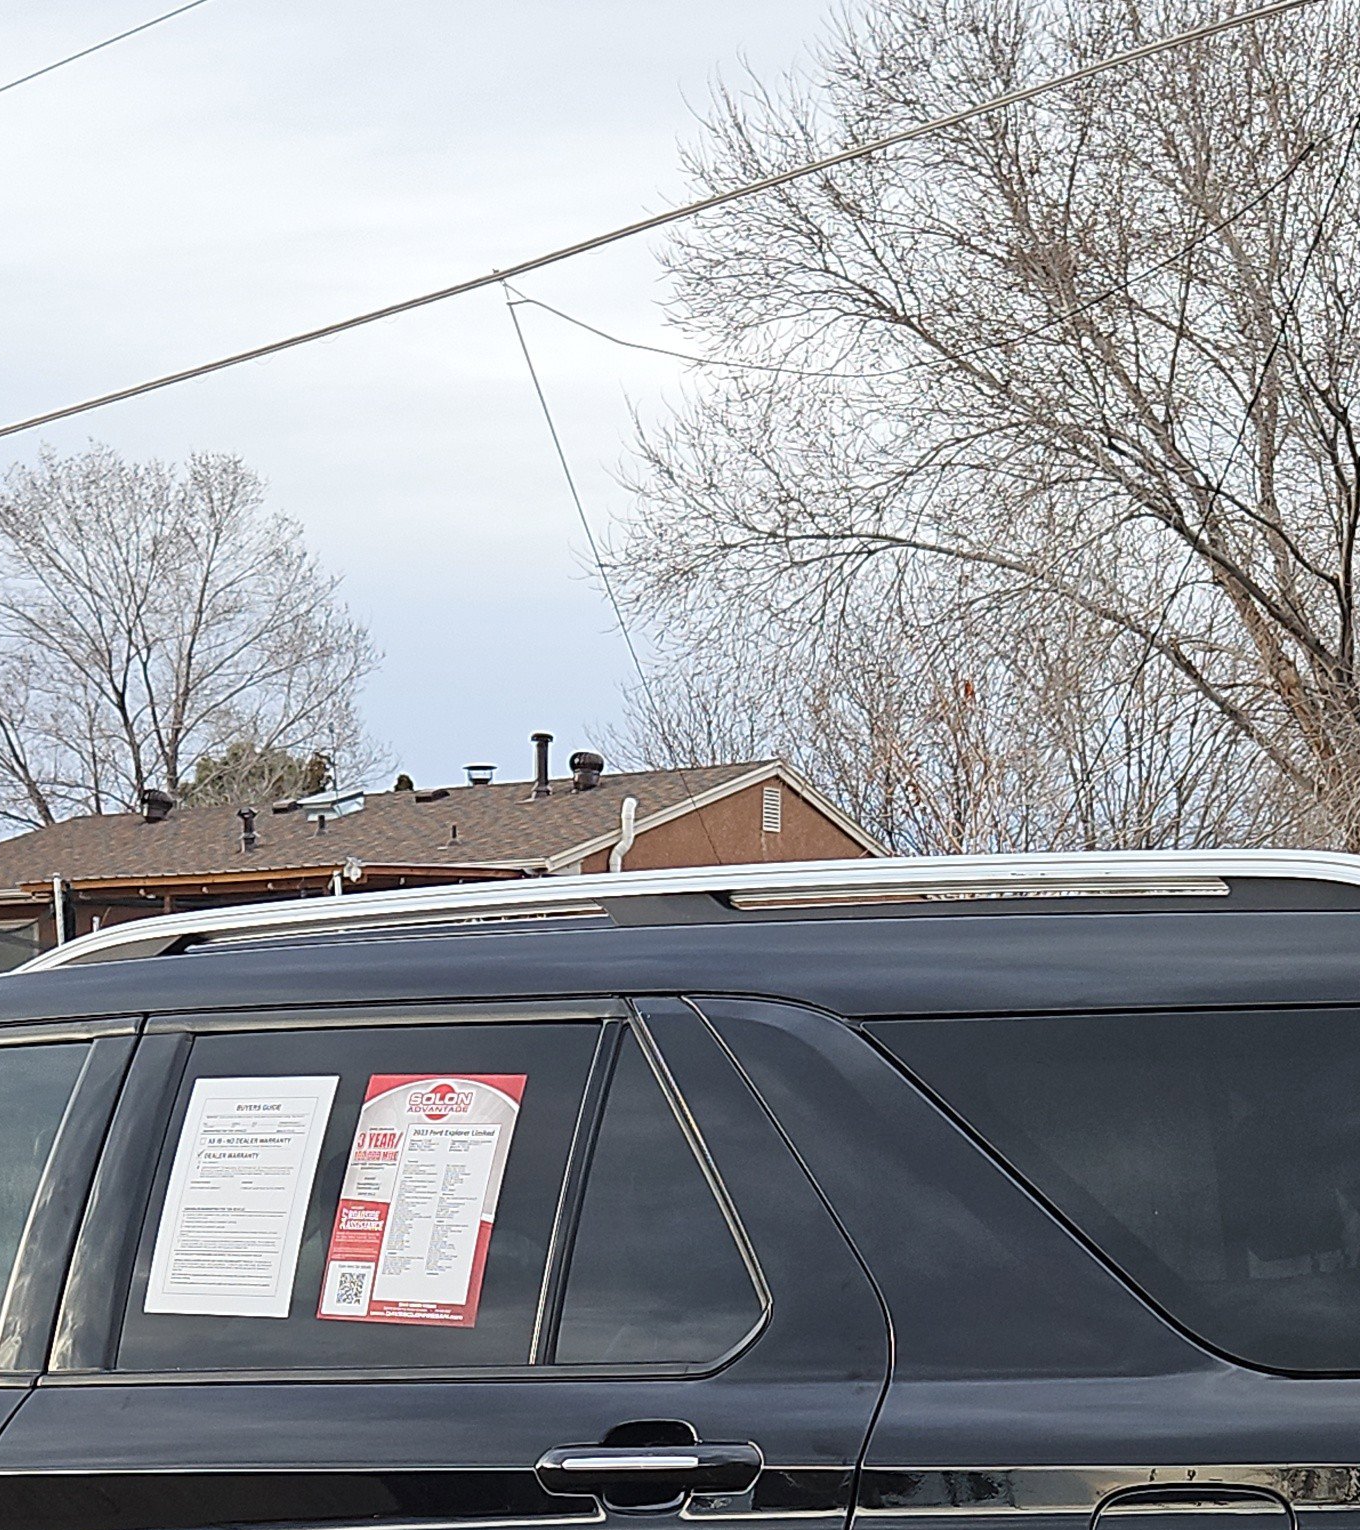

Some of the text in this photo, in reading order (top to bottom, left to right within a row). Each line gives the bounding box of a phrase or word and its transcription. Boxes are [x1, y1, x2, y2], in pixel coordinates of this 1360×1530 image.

[409, 1091, 473, 1105] SOLON
[357, 1132, 366, 1148] 3
[368, 1131, 404, 1149] YEAR/
[444, 1129, 470, 1137] Explorer
